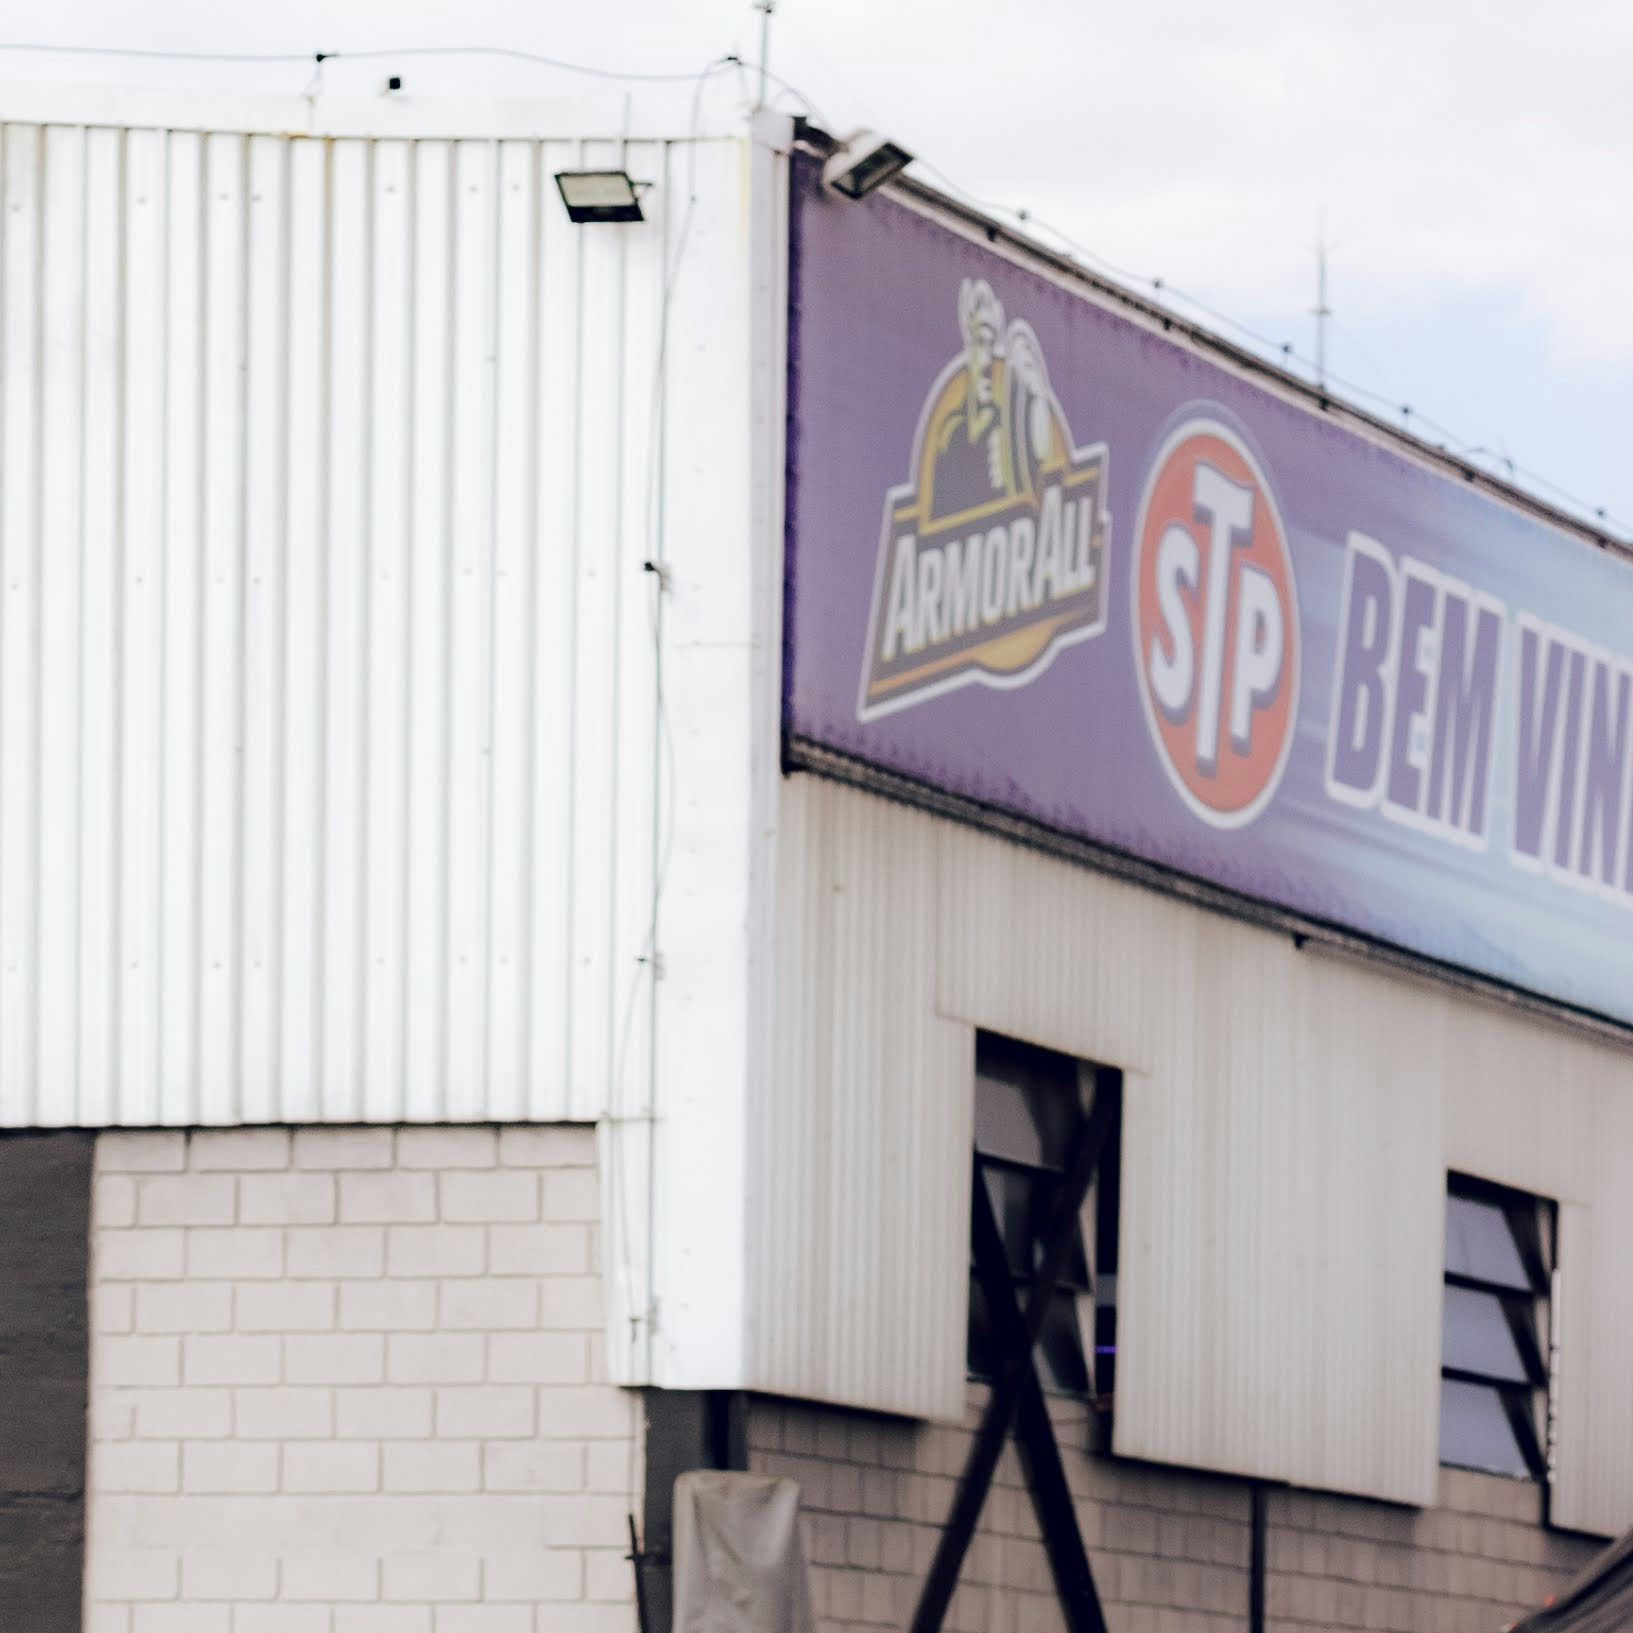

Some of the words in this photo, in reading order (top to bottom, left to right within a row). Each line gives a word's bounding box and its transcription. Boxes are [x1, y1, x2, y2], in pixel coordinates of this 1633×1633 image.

[1150, 461, 1284, 772] STP
[1326, 531, 1506, 853] BEM
[1509, 611, 1633, 910] VIN
